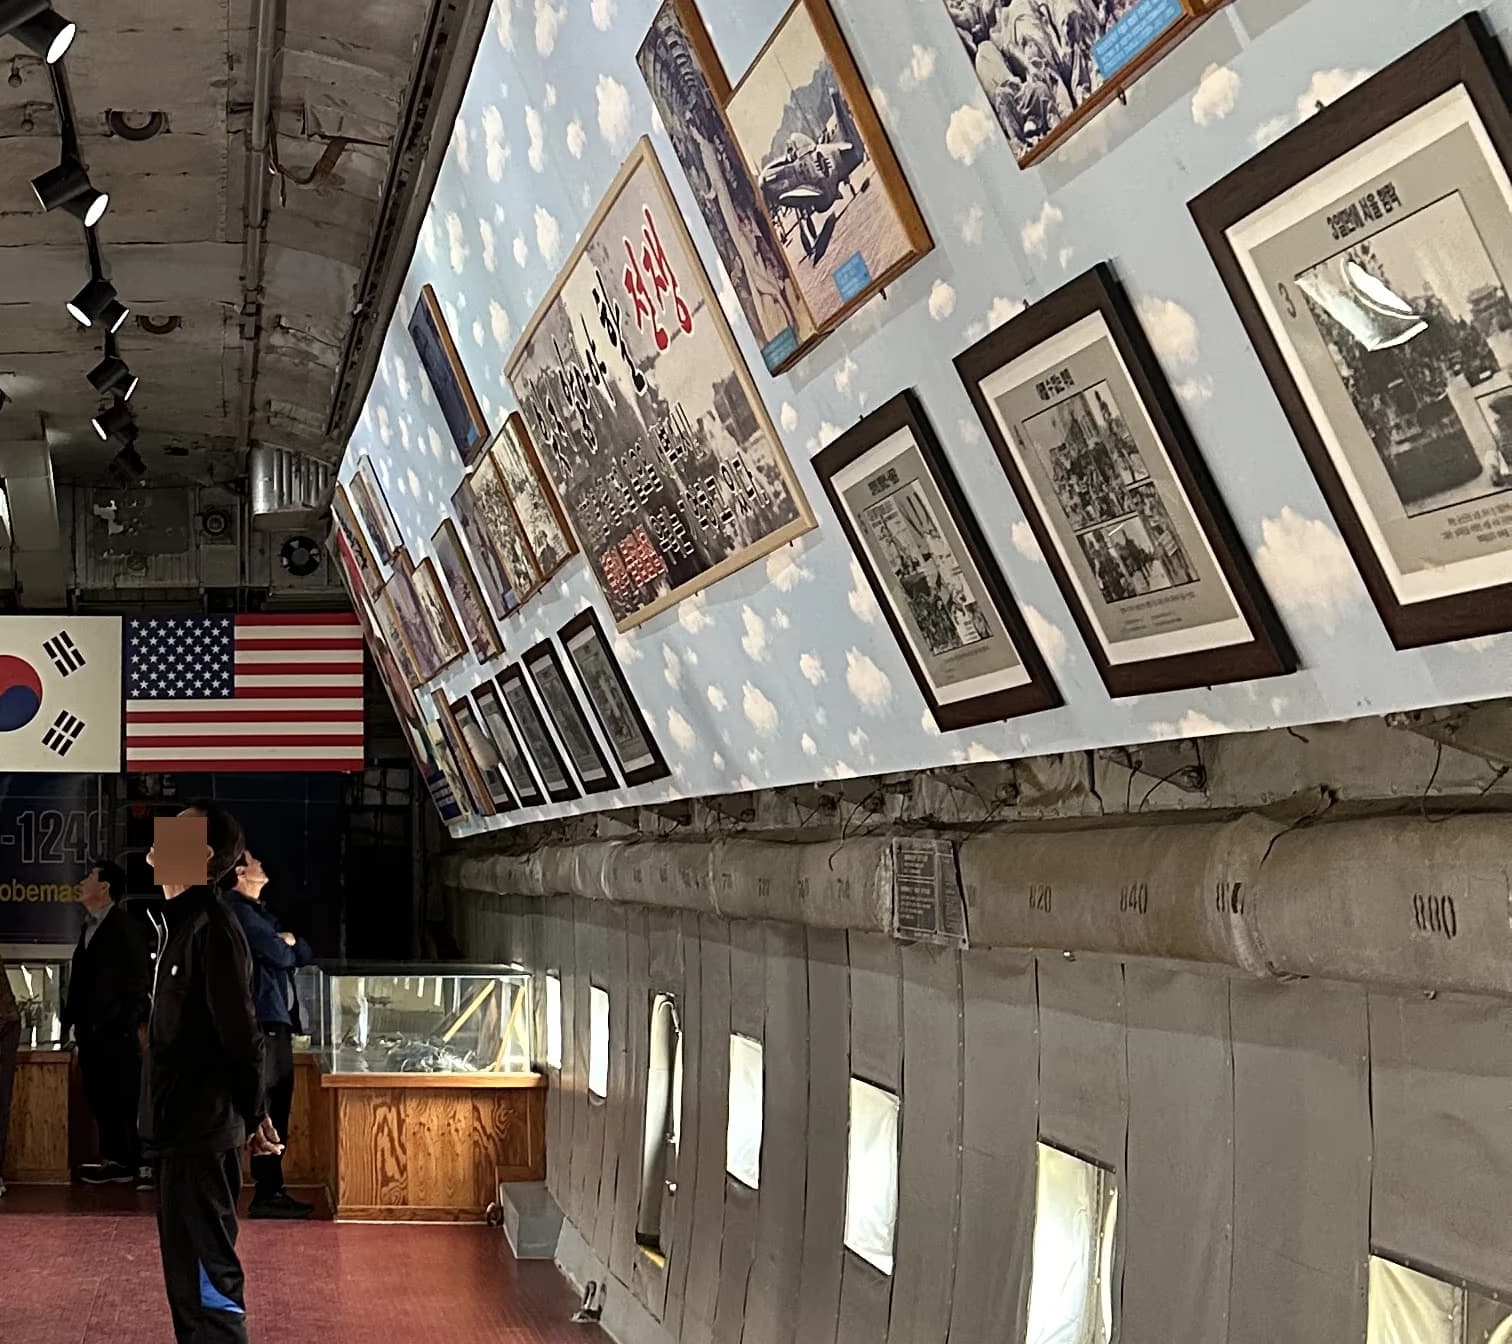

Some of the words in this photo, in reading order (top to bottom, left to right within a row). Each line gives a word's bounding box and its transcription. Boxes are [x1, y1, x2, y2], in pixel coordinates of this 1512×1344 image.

[1358, 192, 1383, 223] 서울
[1376, 181, 1403, 214] 함락
[592, 265, 649, 397] 할
[622, 203, 694, 353] 전쟁
[1278, 283, 1297, 318] 3
[650, 505, 695, 565] 우리는
[677, 475, 734, 545] 기억하고
[719, 451, 770, 514] 있다.
